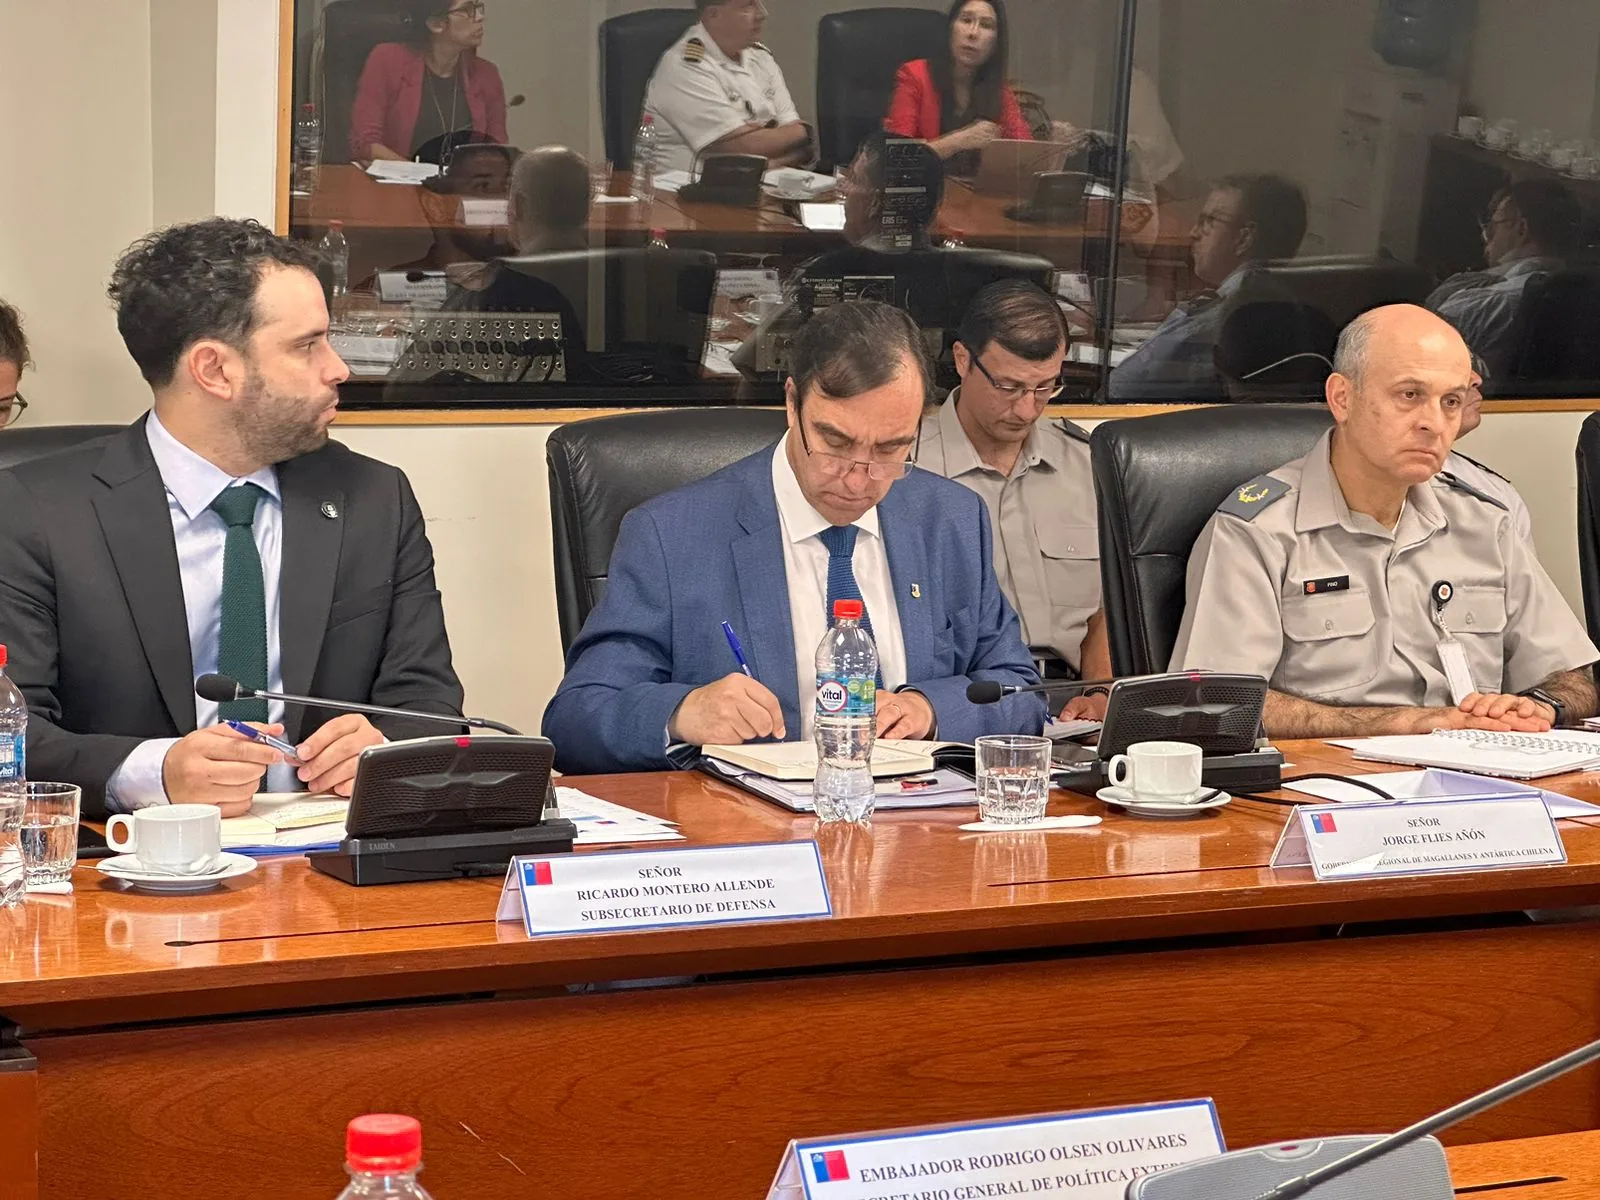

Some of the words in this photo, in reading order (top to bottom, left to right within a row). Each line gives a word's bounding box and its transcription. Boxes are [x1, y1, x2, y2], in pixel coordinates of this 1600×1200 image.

[822, 688, 842, 700] vital
[1407, 816, 1441, 828] SEÑOR
[1382, 834, 1420, 846] JORGE
[1421, 832, 1453, 843] FLIES
[1455, 827, 1486, 841] AÑÓN
[1412, 855, 1423, 864] DE
[1423, 853, 1473, 863] MAGALLANES
[1480, 849, 1521, 859] ANTÁRTICA
[1521, 847, 1554, 856] CHILENA
[638, 865, 682, 879] SEÑOR
[577, 886, 639, 901] RICARDO
[643, 882, 710, 897] MONTERO
[714, 878, 775, 893] ALLENDE
[581, 903, 693, 921] SUBSECRETARIO
[696, 902, 714, 914] DE
[717, 898, 776, 912] DEFENSA
[860, 1158, 965, 1183] EMBAJADOR
[968, 1149, 1046, 1171] RODRIGO
[1049, 1142, 1103, 1161] OLSEN
[1106, 1133, 1188, 1155] OLIVARES
[953, 1180, 1029, 1200] GENERAL
[1031, 1176, 1053, 1192] DE
[1055, 1168, 1129, 1189] POLÍTICA
